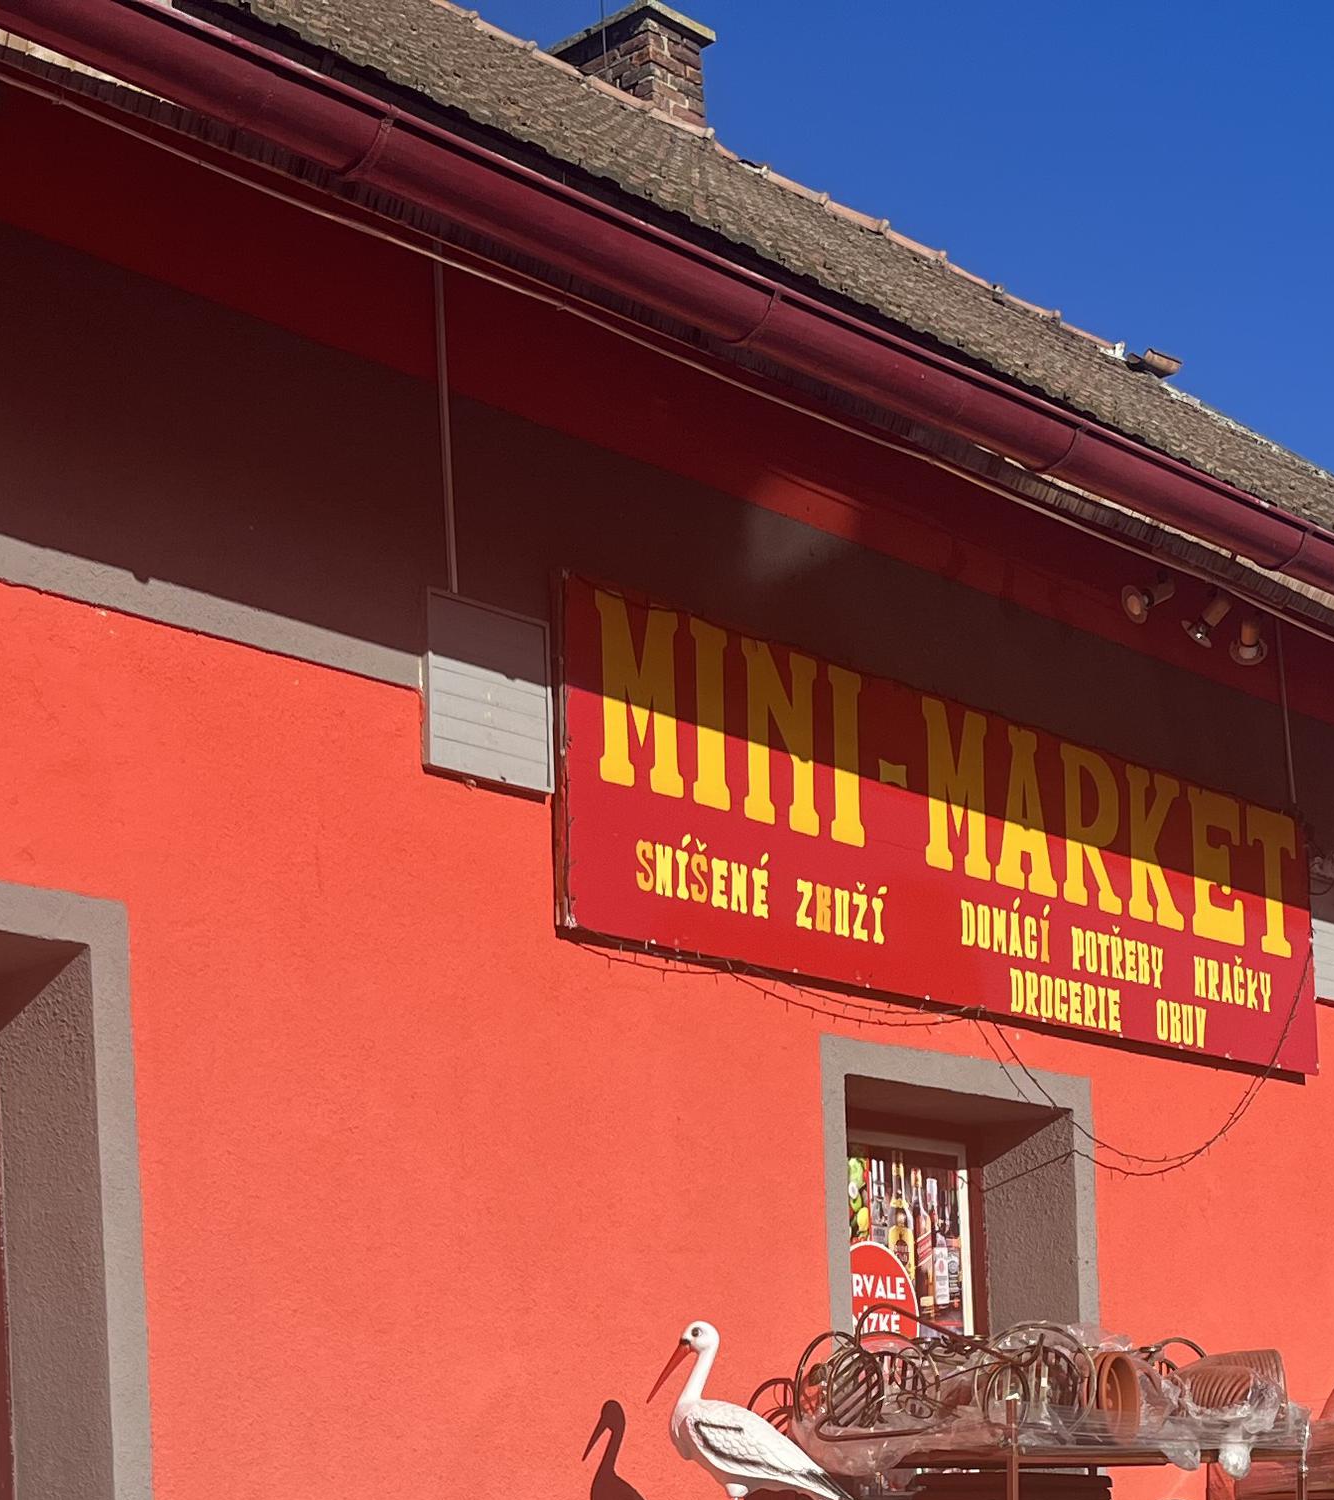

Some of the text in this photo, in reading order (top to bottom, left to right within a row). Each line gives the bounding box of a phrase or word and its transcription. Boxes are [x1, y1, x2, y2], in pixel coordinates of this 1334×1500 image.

[595, 590, 1296, 957] MINI-MARKET
[636, 833, 888, 945] SMÍŠENÉ ZBOŽÍ
[960, 897, 1271, 1012] DOMÁCÍ POTŘEBY HRAČKY
[1009, 968, 1207, 1048] DROGERIE OBUV
